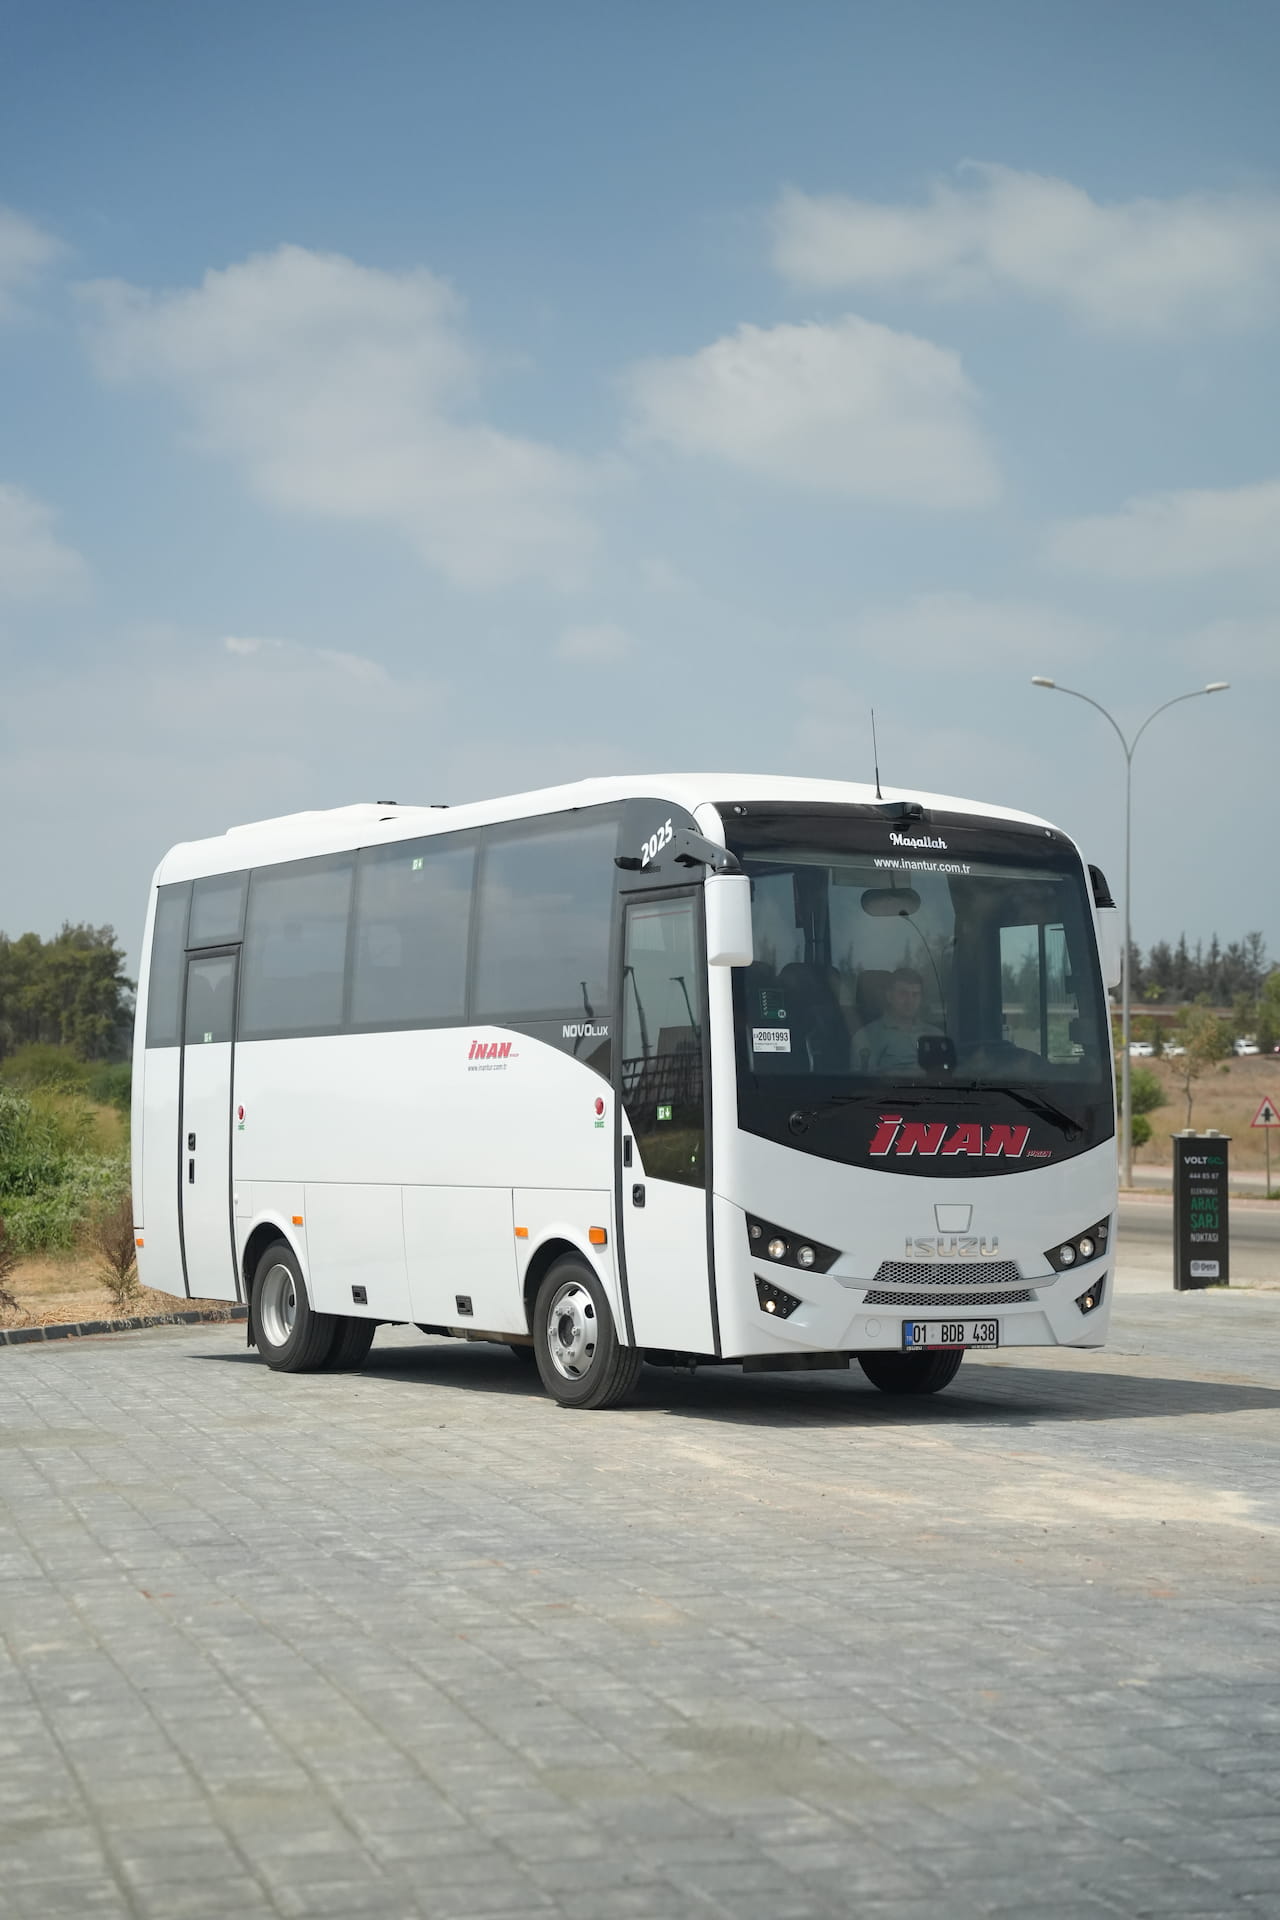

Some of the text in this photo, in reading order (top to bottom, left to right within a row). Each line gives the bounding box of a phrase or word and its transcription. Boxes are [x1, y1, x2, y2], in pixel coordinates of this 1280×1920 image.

[641, 817, 673, 868] 2025
[889, 832, 948, 850] Maşallah
[873, 858, 971, 874] www.inantur.com.tr
[758, 1031, 788, 1041] 2001993
[468, 1040, 512, 1060] İNAN
[868, 1114, 1031, 1158] İNAN
[1190, 1197, 1219, 1211] ARAÇ
[1190, 1213, 1220, 1231] ŞARJ
[1190, 1232, 1219, 1242] NOKTASI
[905, 1237, 998, 1257] ISUZU
[913, 1323, 995, 1343] 01 BDB 438
